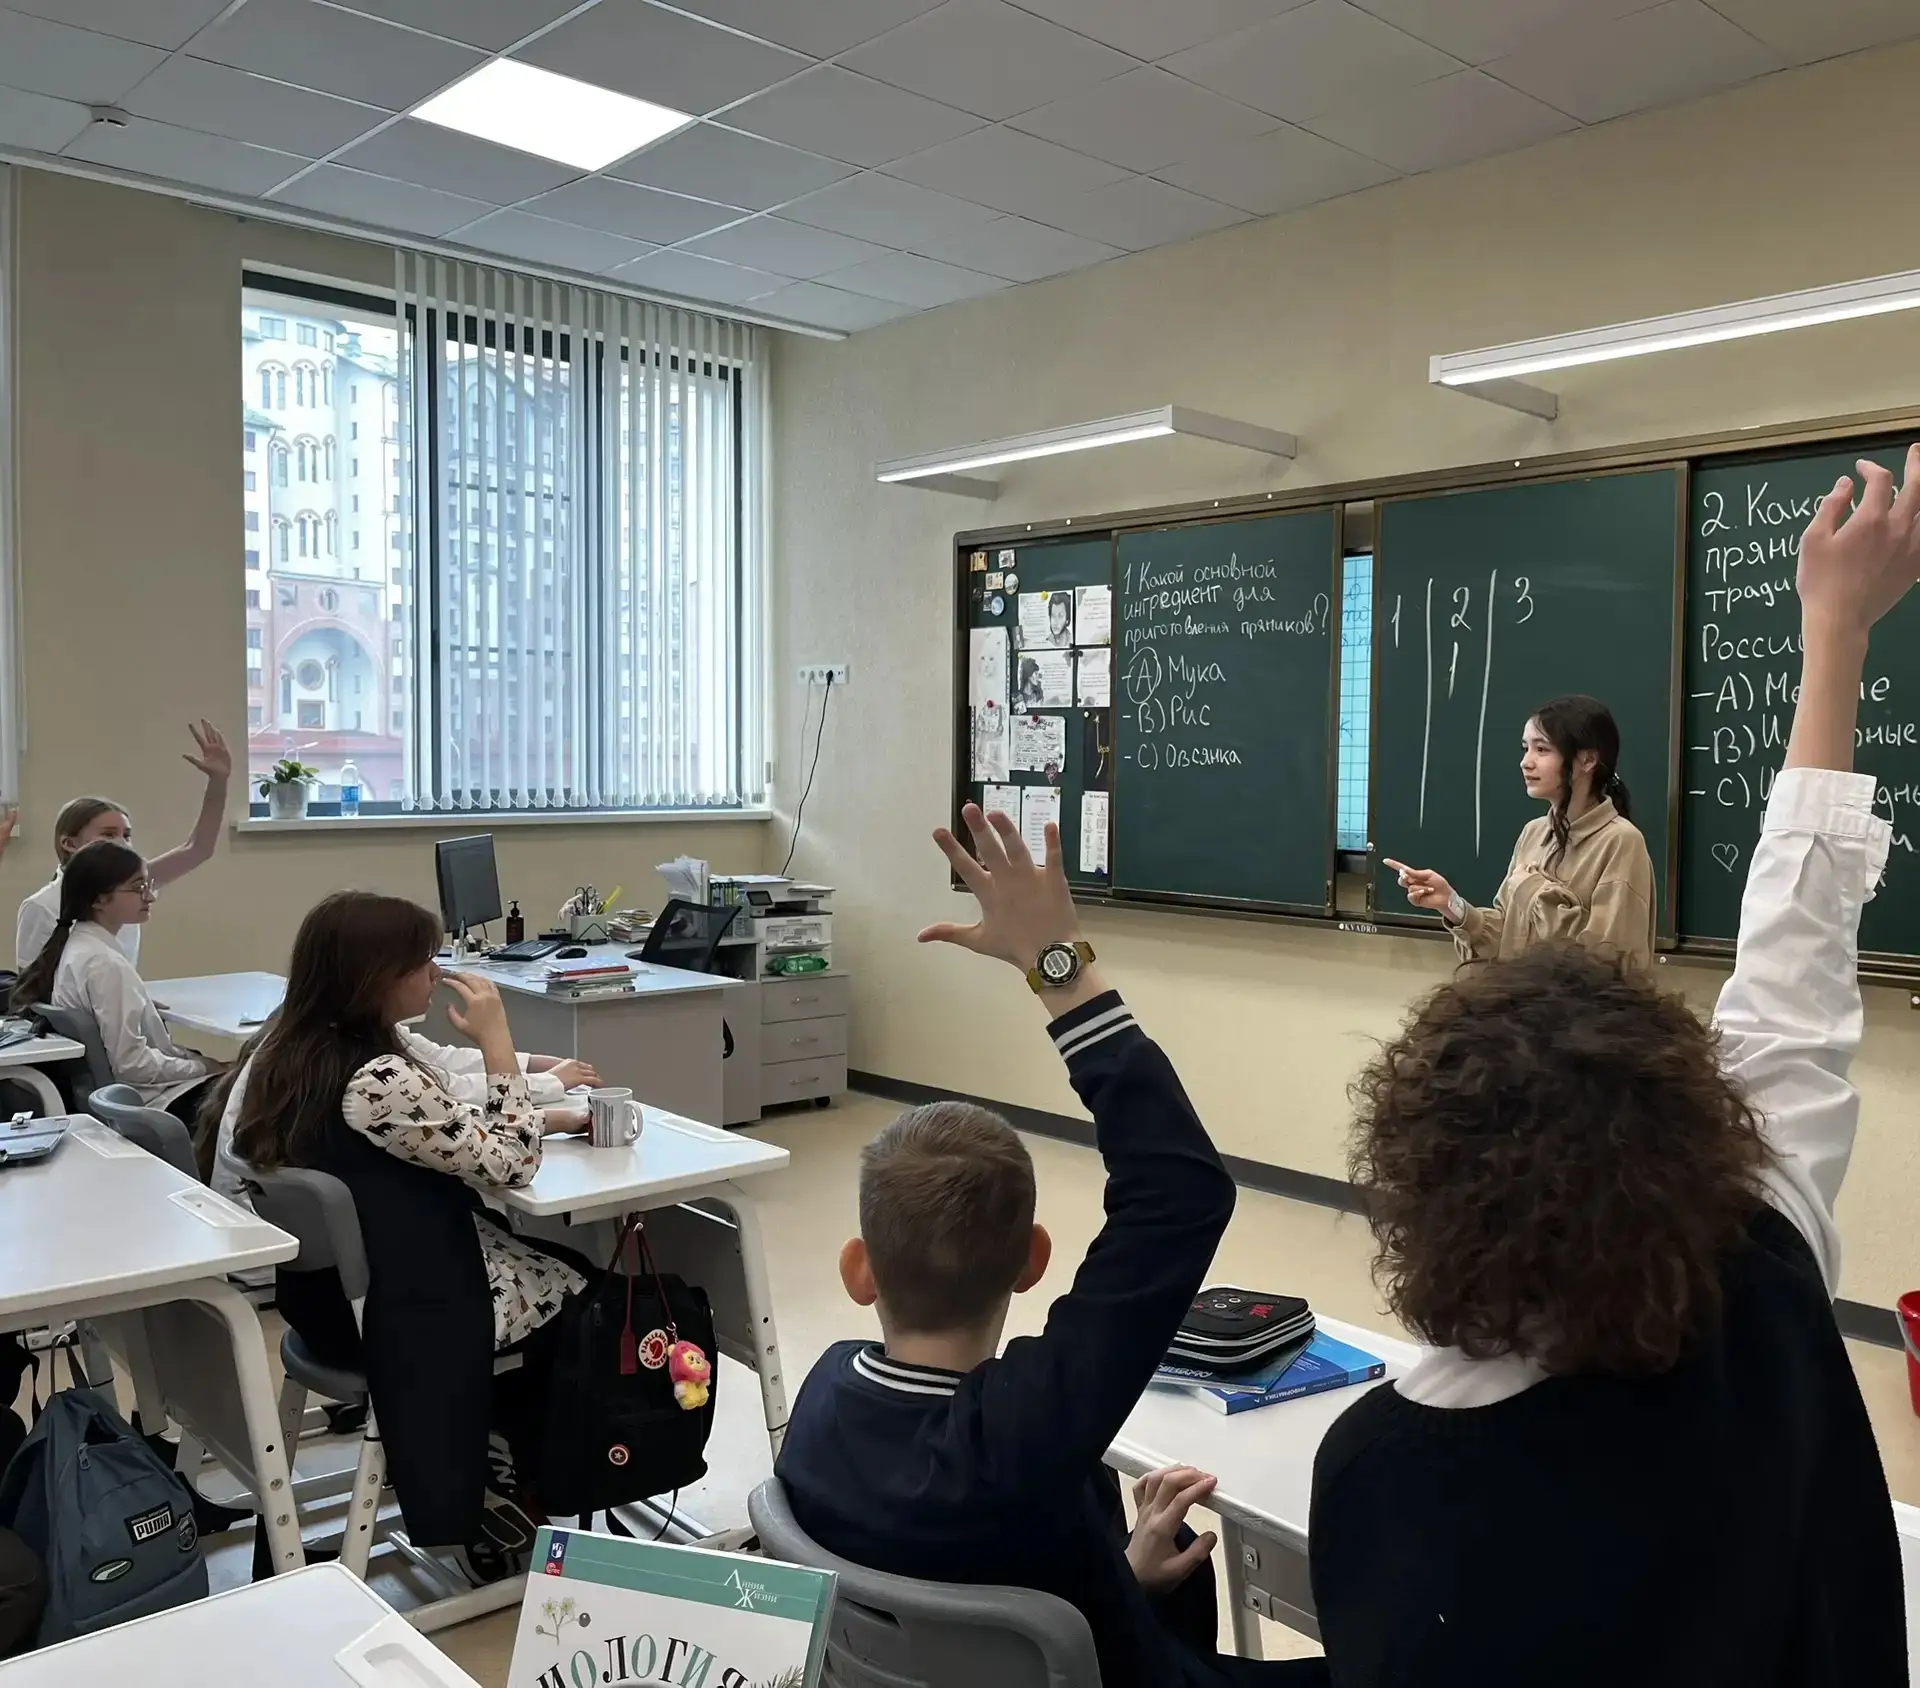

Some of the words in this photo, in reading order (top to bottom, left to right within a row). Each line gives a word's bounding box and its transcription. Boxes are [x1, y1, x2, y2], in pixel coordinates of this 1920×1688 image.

[1124, 563, 1132, 594] 1
[1139, 560, 1184, 593] Какой
[1194, 552, 1278, 583] основной
[1124, 585, 1222, 620] ингредиент
[1233, 586, 1276, 612] для
[1391, 594, 1401, 648] 1
[1450, 586, 1472, 631] 2
[1515, 576, 1534, 624] 3
[1125, 615, 1230, 652] приготовления
[1168, 655, 1226, 700] Мука
[1171, 694, 1210, 726] Рис
[1166, 743, 1241, 768] Овсянка
[1264, 1386, 1307, 1401] ИНФОРМАТИКА
[136, 1513, 169, 1538] PUMA
[723, 1568, 765, 1590] Линия
[734, 1588, 778, 1609] Жизни
[536, 1634, 749, 1688] ИОЛОГИЯ
